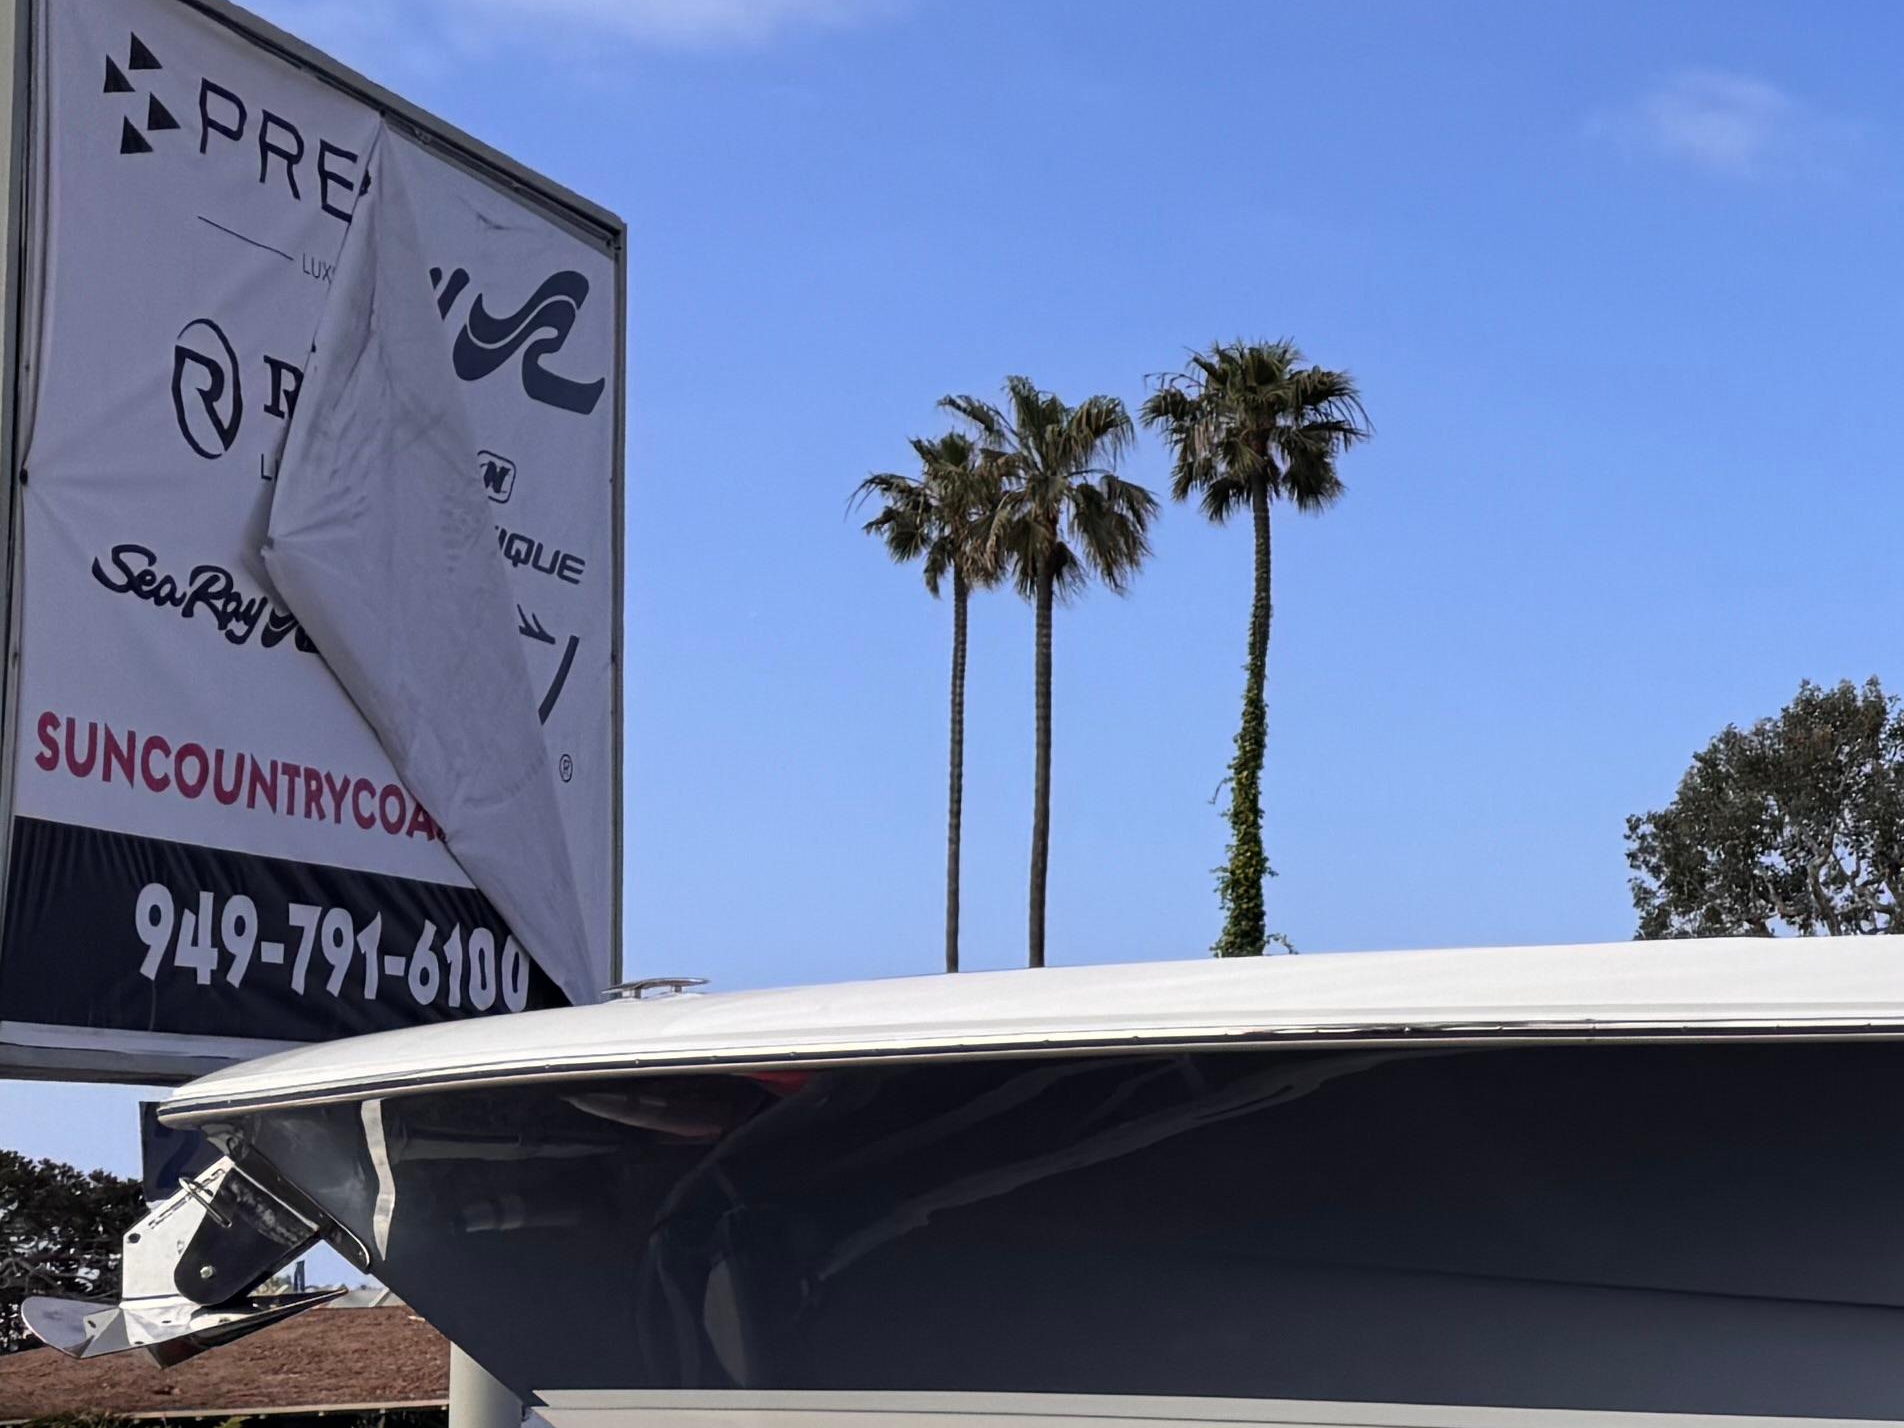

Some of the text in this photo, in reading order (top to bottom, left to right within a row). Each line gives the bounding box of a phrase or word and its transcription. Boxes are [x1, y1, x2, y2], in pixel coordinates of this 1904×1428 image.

[198, 76, 366, 225] PRE
[302, 252, 335, 285] LUX
[495, 525, 585, 585] IQUE
[35, 710, 443, 843] SUNCOUNTRYCOA
[134, 882, 531, 1014] 949-791-6100
